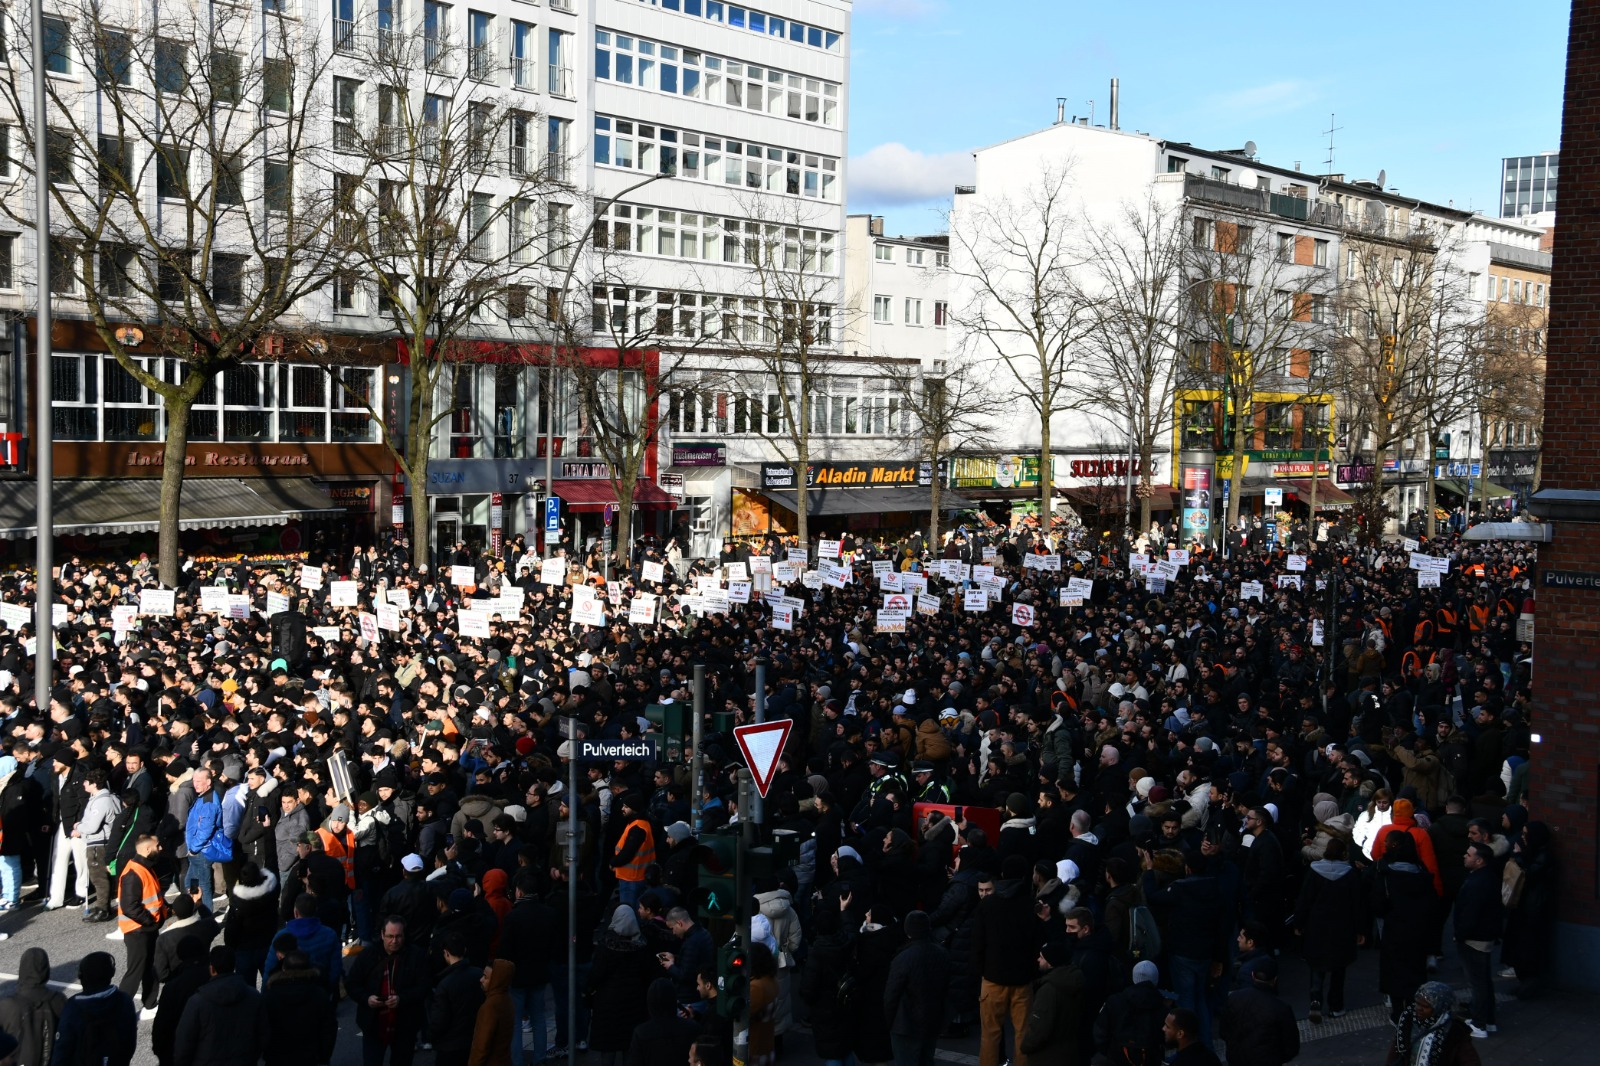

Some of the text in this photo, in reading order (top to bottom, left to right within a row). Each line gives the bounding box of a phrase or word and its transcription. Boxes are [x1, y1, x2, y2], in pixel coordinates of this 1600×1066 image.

[128, 450, 310, 466] Indn Restaurant
[1295, 464, 1310, 472] PLAZA
[431, 472, 465, 484] SUZAN
[508, 473, 519, 484] 37
[815, 468, 866, 484] Aladin
[870, 466, 915, 483] Markt
[583, 743, 650, 756] Pulverteich
